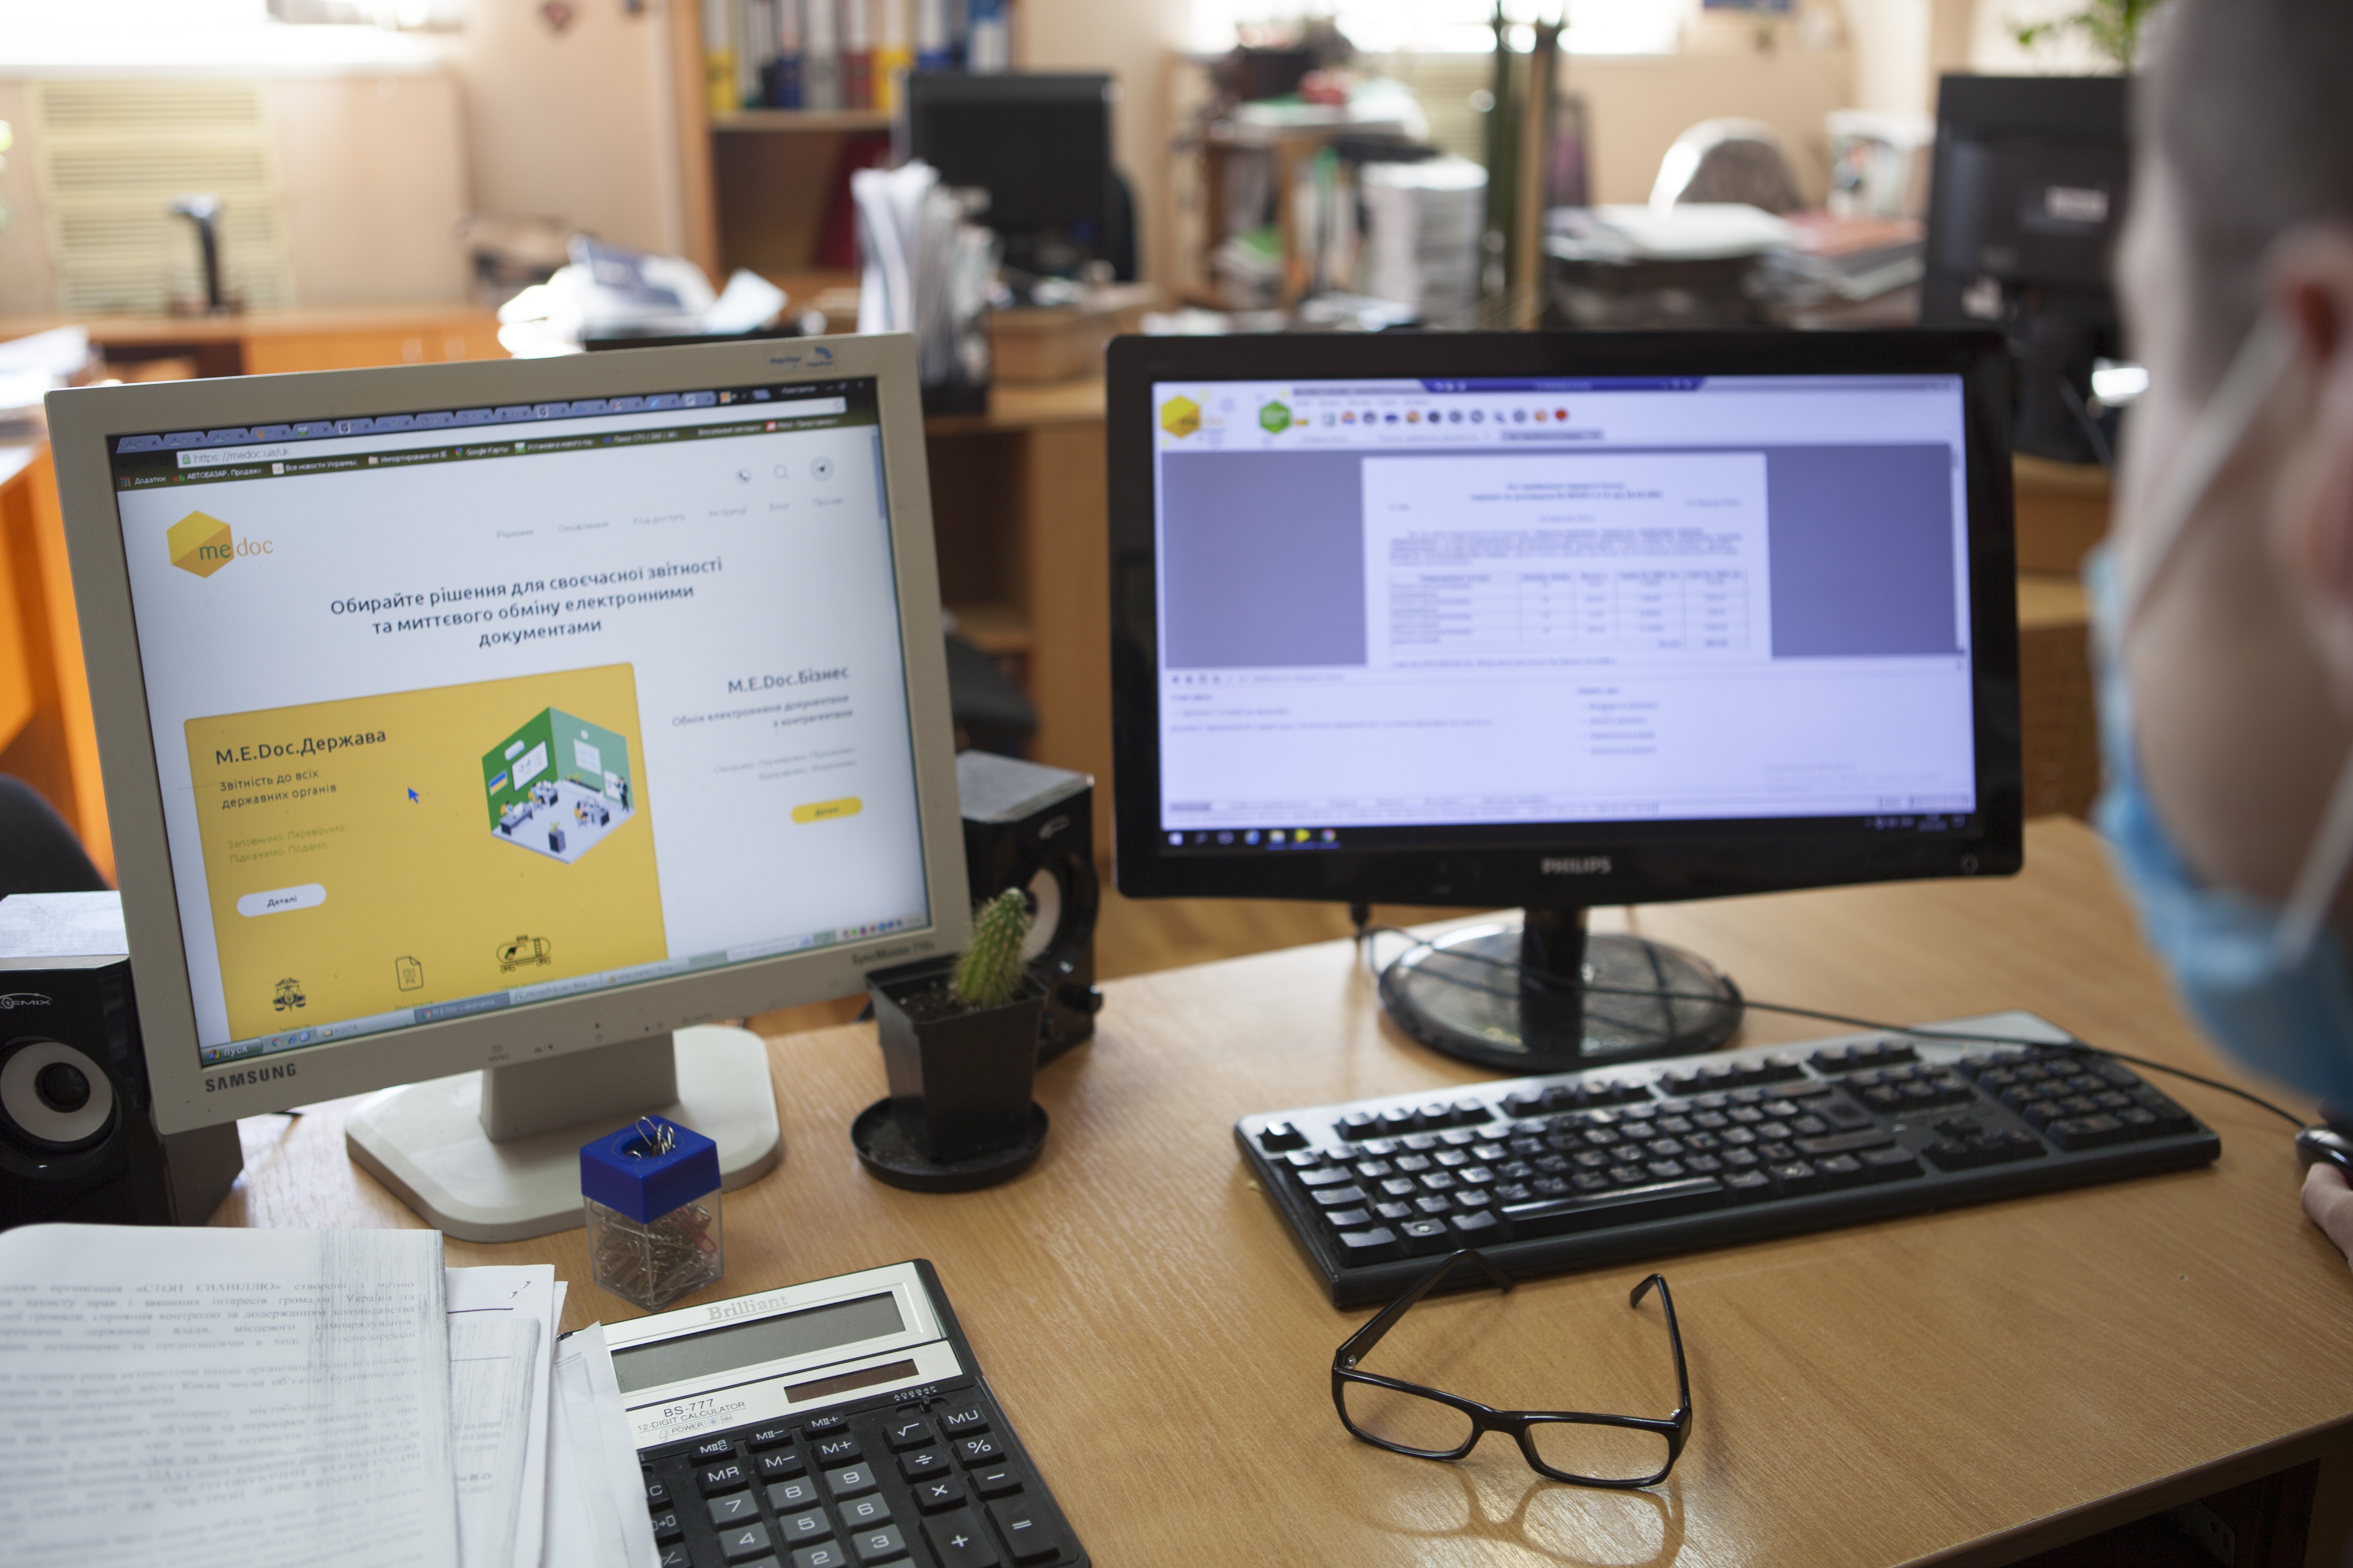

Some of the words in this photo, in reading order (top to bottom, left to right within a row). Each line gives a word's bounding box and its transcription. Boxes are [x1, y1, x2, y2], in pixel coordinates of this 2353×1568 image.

[465, 448, 486, 457] Google
[135, 476, 166, 485] Додатки
[331, 592, 425, 614] Обирайте
[429, 584, 507, 607] рішення
[511, 580, 545, 597] для
[550, 566, 644, 590] своєчасної
[648, 556, 722, 580] звітності
[372, 621, 392, 634] та
[397, 609, 493, 632] миттєвого
[498, 600, 560, 620] обміну
[565, 586, 694, 612] електронними
[479, 620, 601, 648] документами
[220, 776, 274, 792] Звітність
[276, 774, 292, 785] до
[296, 768, 319, 781] всіх
[222, 791, 289, 810] державних
[292, 783, 337, 799] органів
[1541, 856, 1612, 874] PHILIPS
[267, 894, 297, 908] Деталі
[224, 1044, 249, 1058] пуск
[205, 1063, 297, 1093] SAMSUNG
[136, 1284, 183, 1293] «СТОП
[212, 1295, 267, 1307] інтересів
[346, 1294, 391, 1303] України
[159, 1311, 220, 1322] контролю
[244, 1308, 326, 1320] додержанням
[706, 1295, 788, 1321] Brilliant
[234, 1324, 296, 1334] місцевого
[664, 1399, 714, 1417] BS-777
[638, 1417, 678, 1431] 12-DIGIT
[681, 1401, 746, 1422] CALCULATOR
[948, 1409, 979, 1424] MU
[672, 1422, 704, 1434] POWER
[822, 1440, 852, 1455] M+
[967, 1439, 992, 1454] %
[708, 1466, 739, 1482] MR
[843, 1471, 860, 1484] 9
[649, 1485, 663, 1496] C
[785, 1486, 802, 1499] 8
[725, 1499, 742, 1513] 7
[857, 1503, 874, 1516] 6
[797, 1517, 816, 1531] 5
[1012, 1520, 1032, 1530] =
[739, 1532, 756, 1546] 4
[871, 1535, 889, 1549] 3
[951, 1534, 969, 1547] +
[811, 1550, 830, 1566] 2
